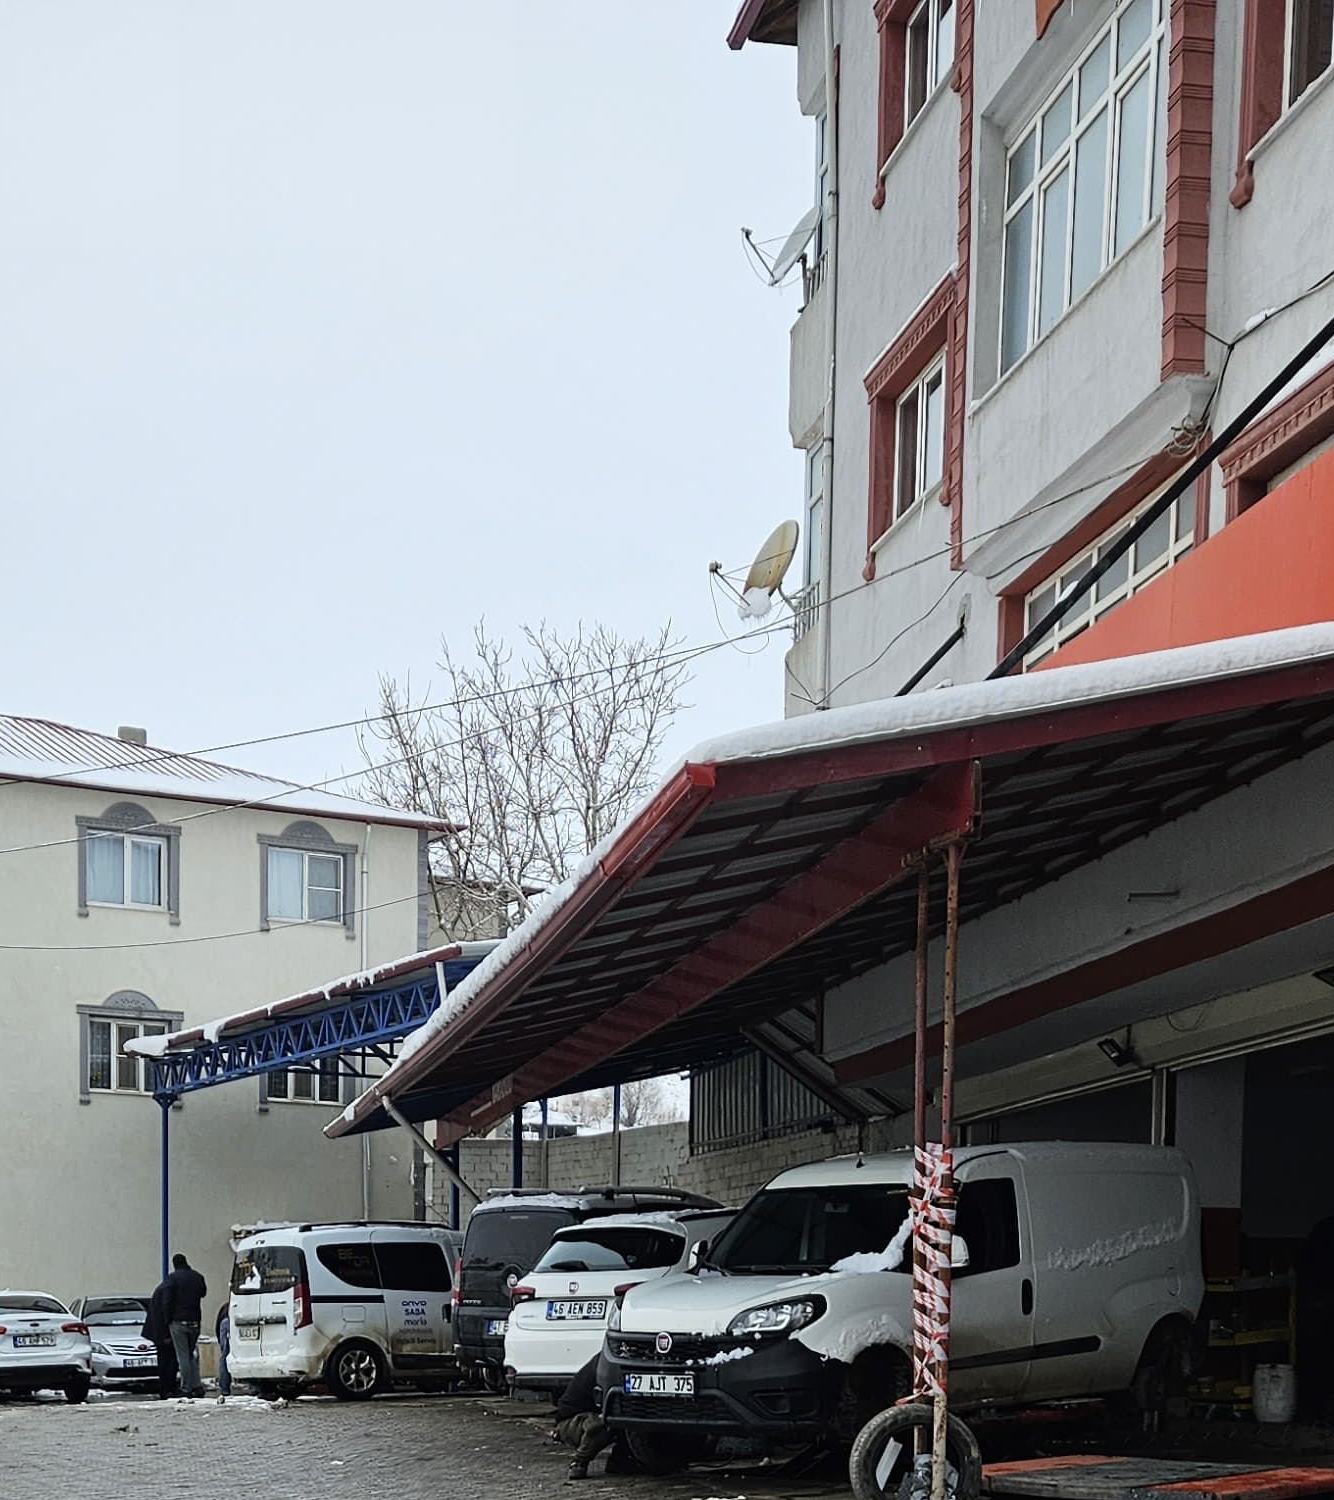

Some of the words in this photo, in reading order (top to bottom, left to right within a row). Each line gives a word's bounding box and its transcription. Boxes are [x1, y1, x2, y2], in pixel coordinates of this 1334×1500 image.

[554, 1303, 564, 1315] 46
[568, 1302, 584, 1314] AEN
[586, 1302, 604, 1314] 859
[632, 1375, 643, 1390] 27
[649, 1375, 667, 1391] AJT
[673, 1376, 693, 1392] 375
